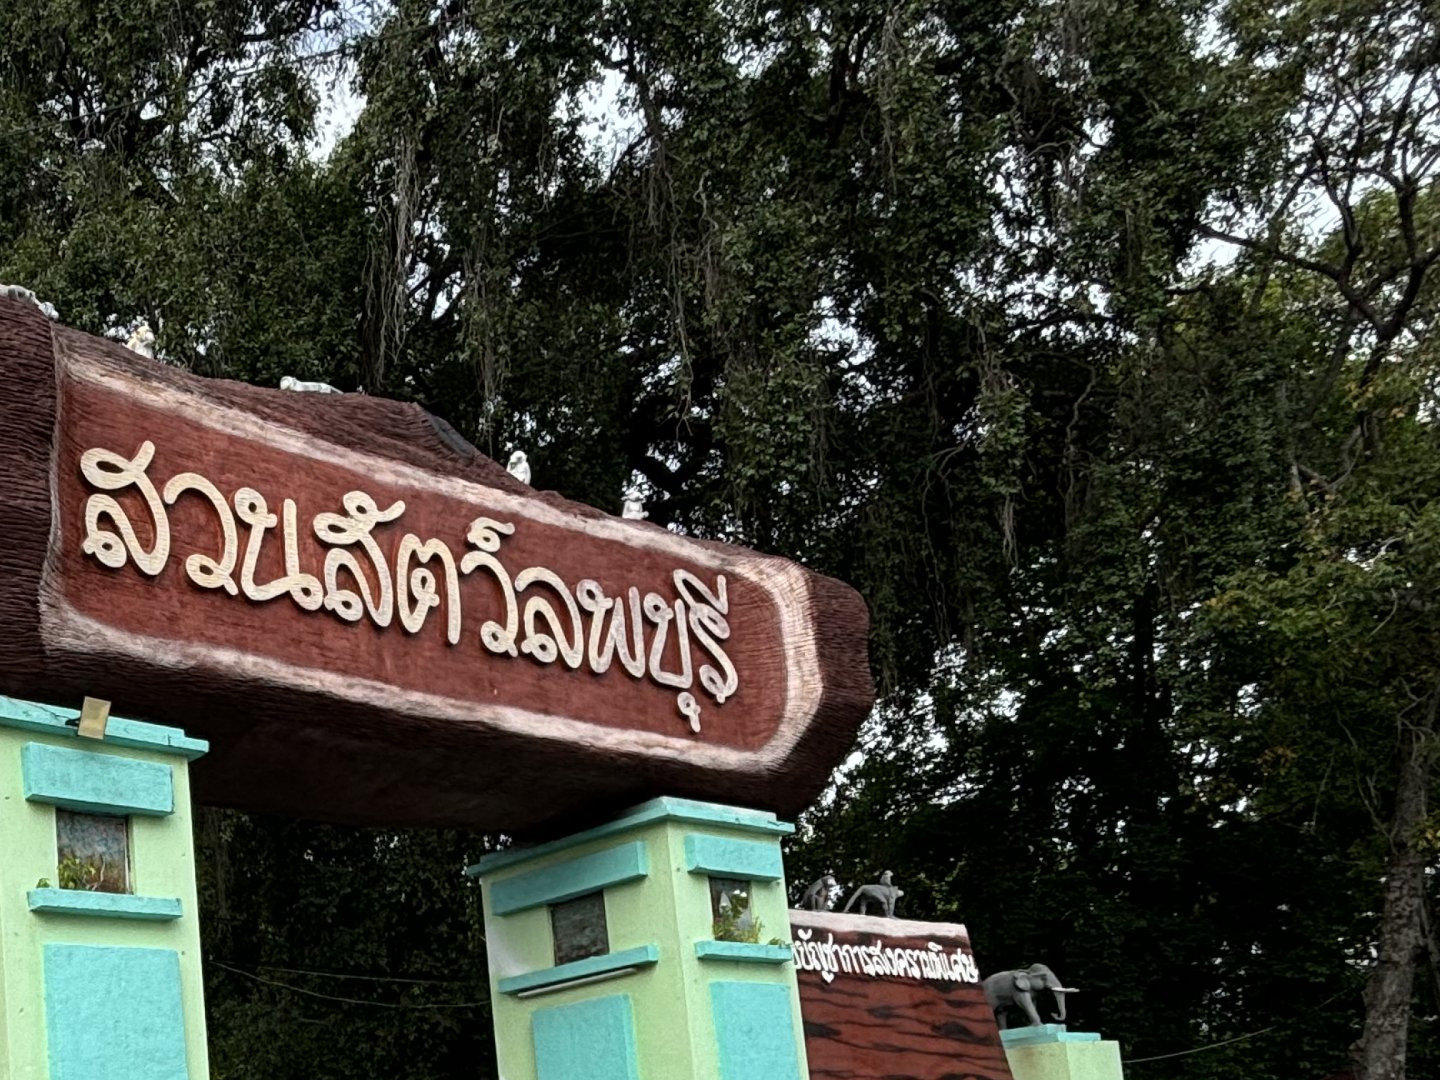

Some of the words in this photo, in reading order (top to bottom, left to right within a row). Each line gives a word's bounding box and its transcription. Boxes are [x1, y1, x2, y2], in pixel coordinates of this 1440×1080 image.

[79, 440, 740, 734] สวนสัตว์ลพบุรี
